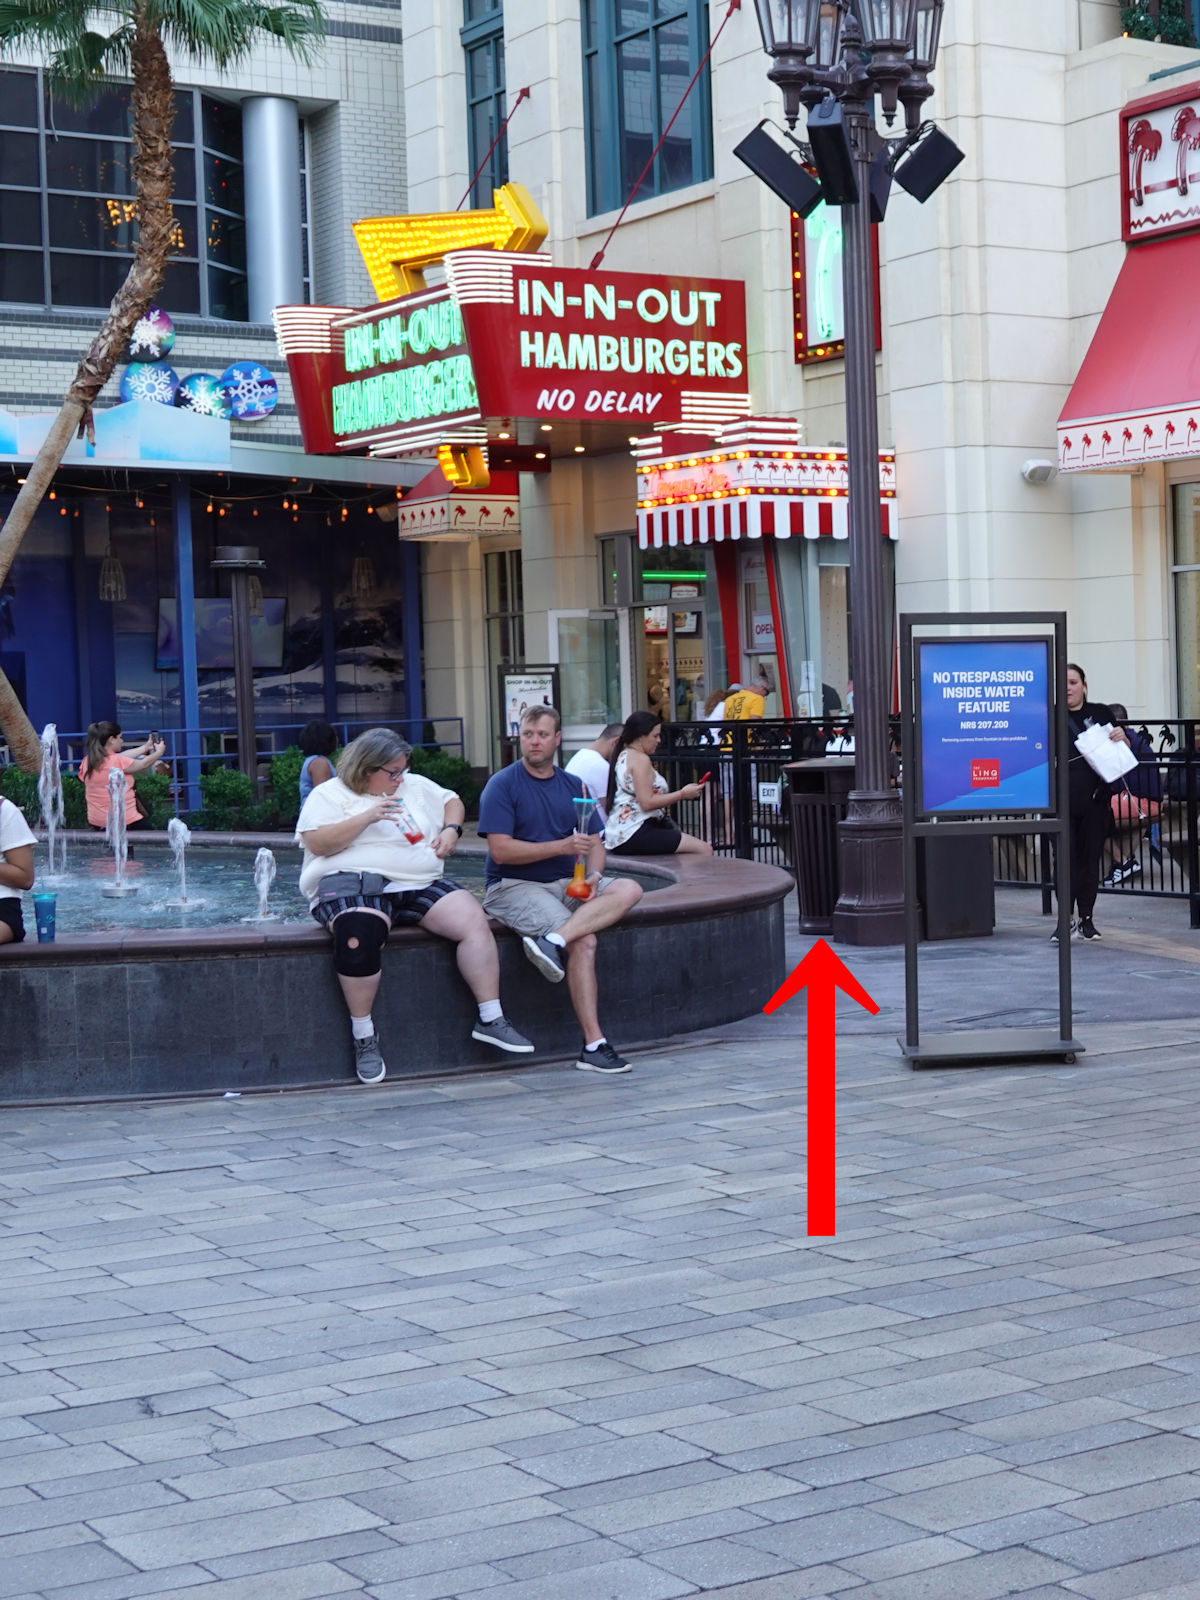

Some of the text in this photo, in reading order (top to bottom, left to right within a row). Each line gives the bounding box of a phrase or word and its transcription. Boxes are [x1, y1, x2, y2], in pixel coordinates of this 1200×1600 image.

[518, 279, 721, 327] IN-N-OUT
[344, 299, 463, 372] IN-N-OUT
[520, 330, 743, 378] HAMBURGERS
[537, 388, 662, 414] NO DELAY
[933, 670, 1034, 684] NO TRESPASSING
[943, 686, 1025, 699] INSIDE WATER
[958, 701, 1010, 713] FEATURE
[960, 720, 1009, 730] NRS 207.200
[972, 769, 998, 777] LINQ
[762, 788, 776, 797] EXIT
